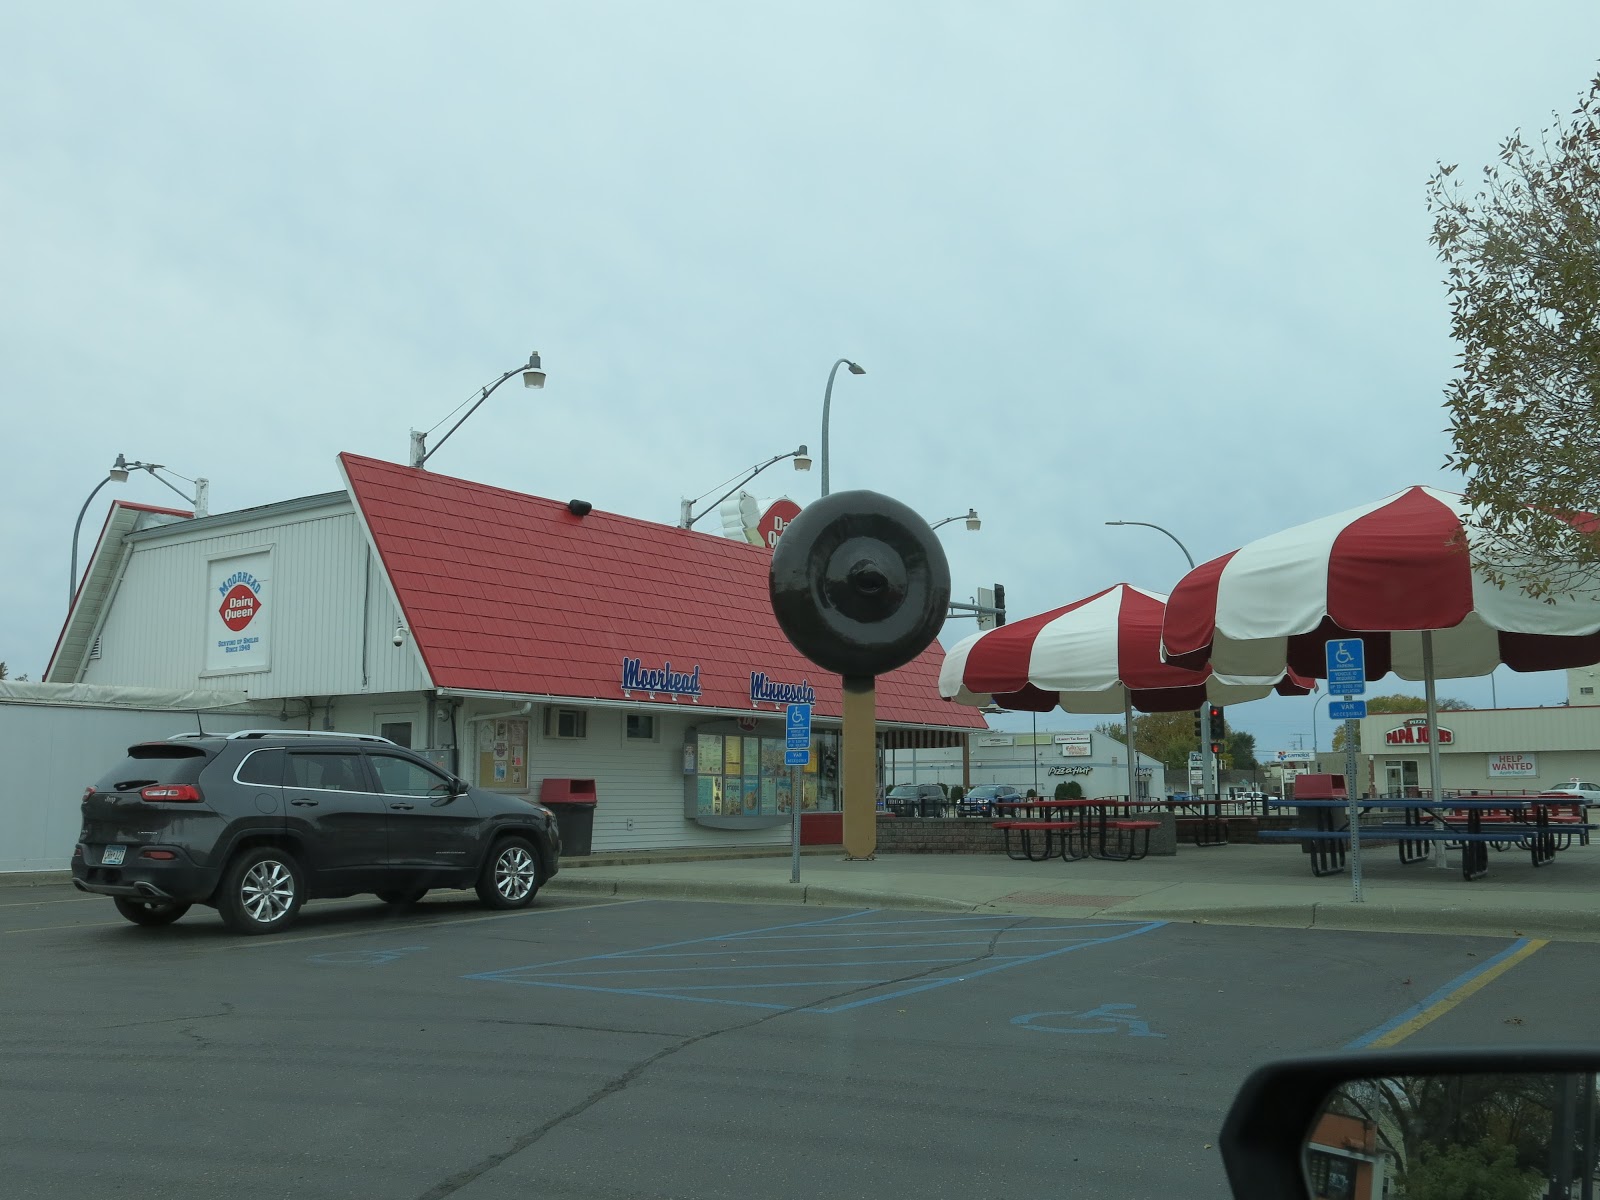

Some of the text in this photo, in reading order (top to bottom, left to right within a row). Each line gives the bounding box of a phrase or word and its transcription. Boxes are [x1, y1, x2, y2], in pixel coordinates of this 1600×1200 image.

[219, 571, 261, 597] MOORHEAD
[229, 596, 254, 608] Dairy
[225, 608, 253, 621] Queen
[622, 656, 701, 695] Moorhead
[750, 671, 815, 704] Minnesota
[1386, 727, 1415, 743] PAPA
[1499, 755, 1523, 763] HELP
[1048, 766, 1091, 776] Pizza Hut
[1492, 762, 1533, 770] WANTED
[104, 796, 116, 805] Jeep
